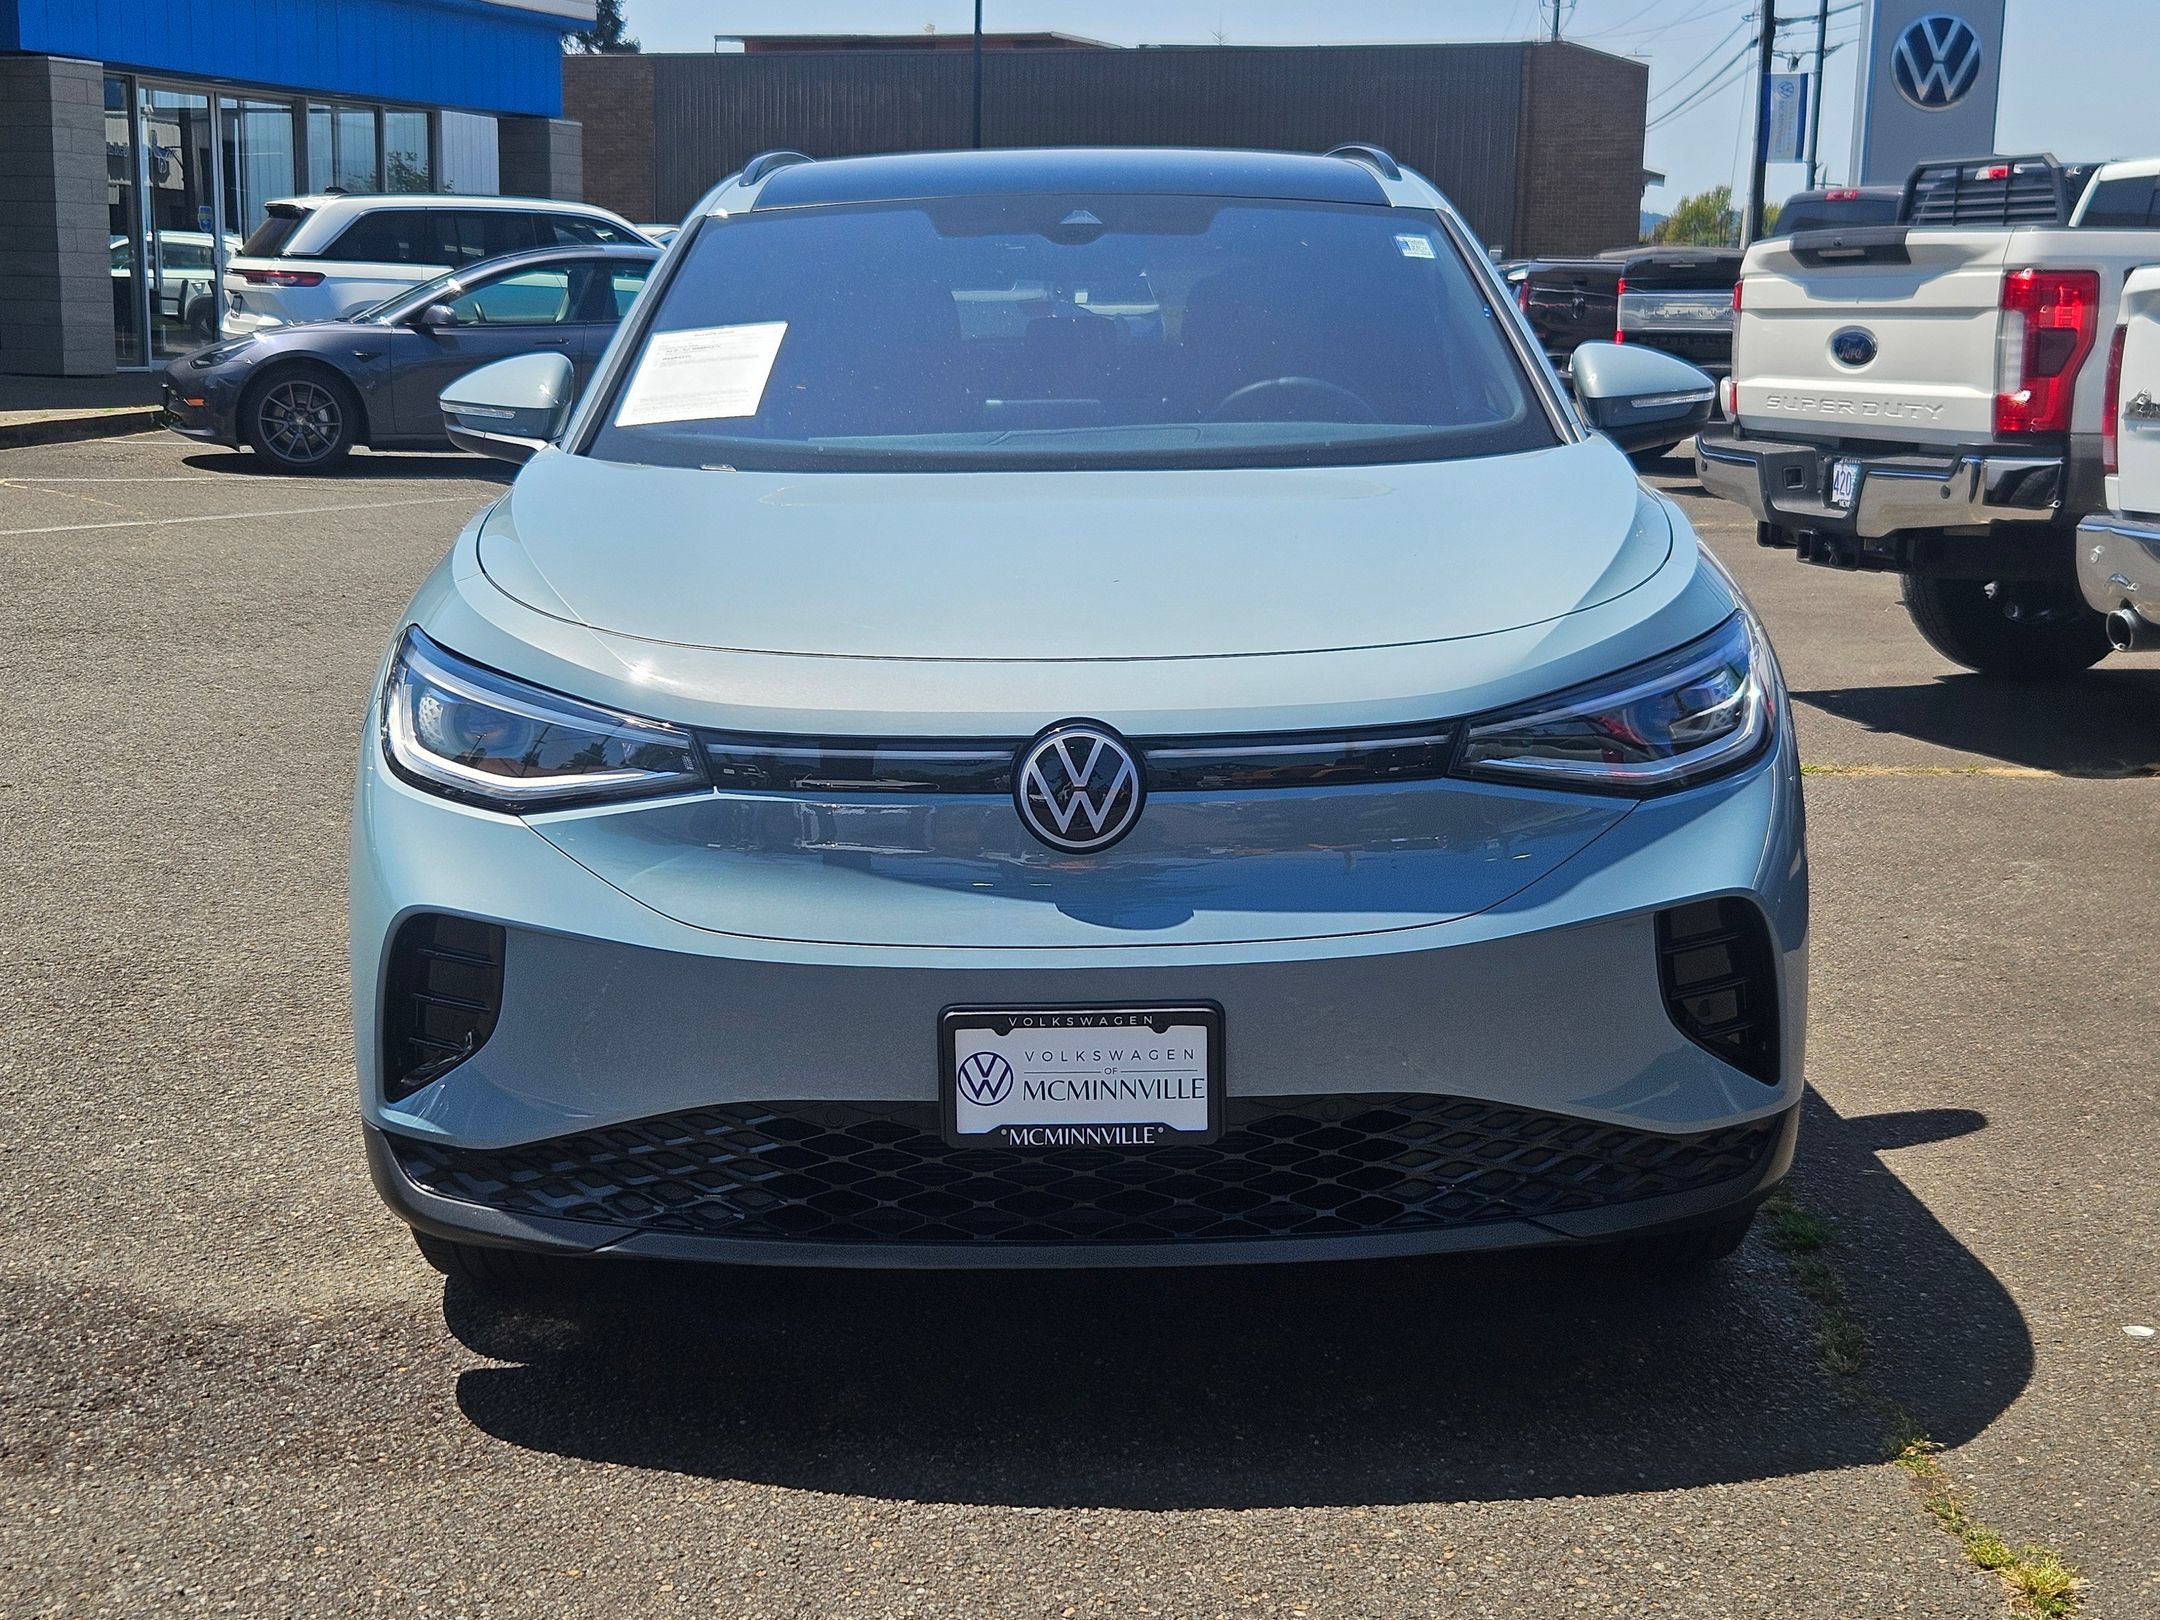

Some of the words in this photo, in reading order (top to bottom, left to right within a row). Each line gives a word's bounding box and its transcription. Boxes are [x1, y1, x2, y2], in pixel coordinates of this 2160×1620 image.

[1895, 15, 1982, 104] VW
[1838, 341, 1866, 360] Ford
[1766, 395, 1855, 415] SUPER
[1862, 402, 1945, 420] DUTY
[1833, 470, 1852, 497] 420
[1024, 736, 1136, 837] VW
[1008, 1015, 1154, 1027] VOLKSWAGEN
[1024, 1049, 1195, 1063] VOLKSWAGEN
[958, 1052, 1014, 1106] VW
[1104, 1066, 1118, 1076] OF
[1023, 1078, 1206, 1101] MCMINNVILLE
[1008, 1126, 1156, 1146] MCMINNVILLE
